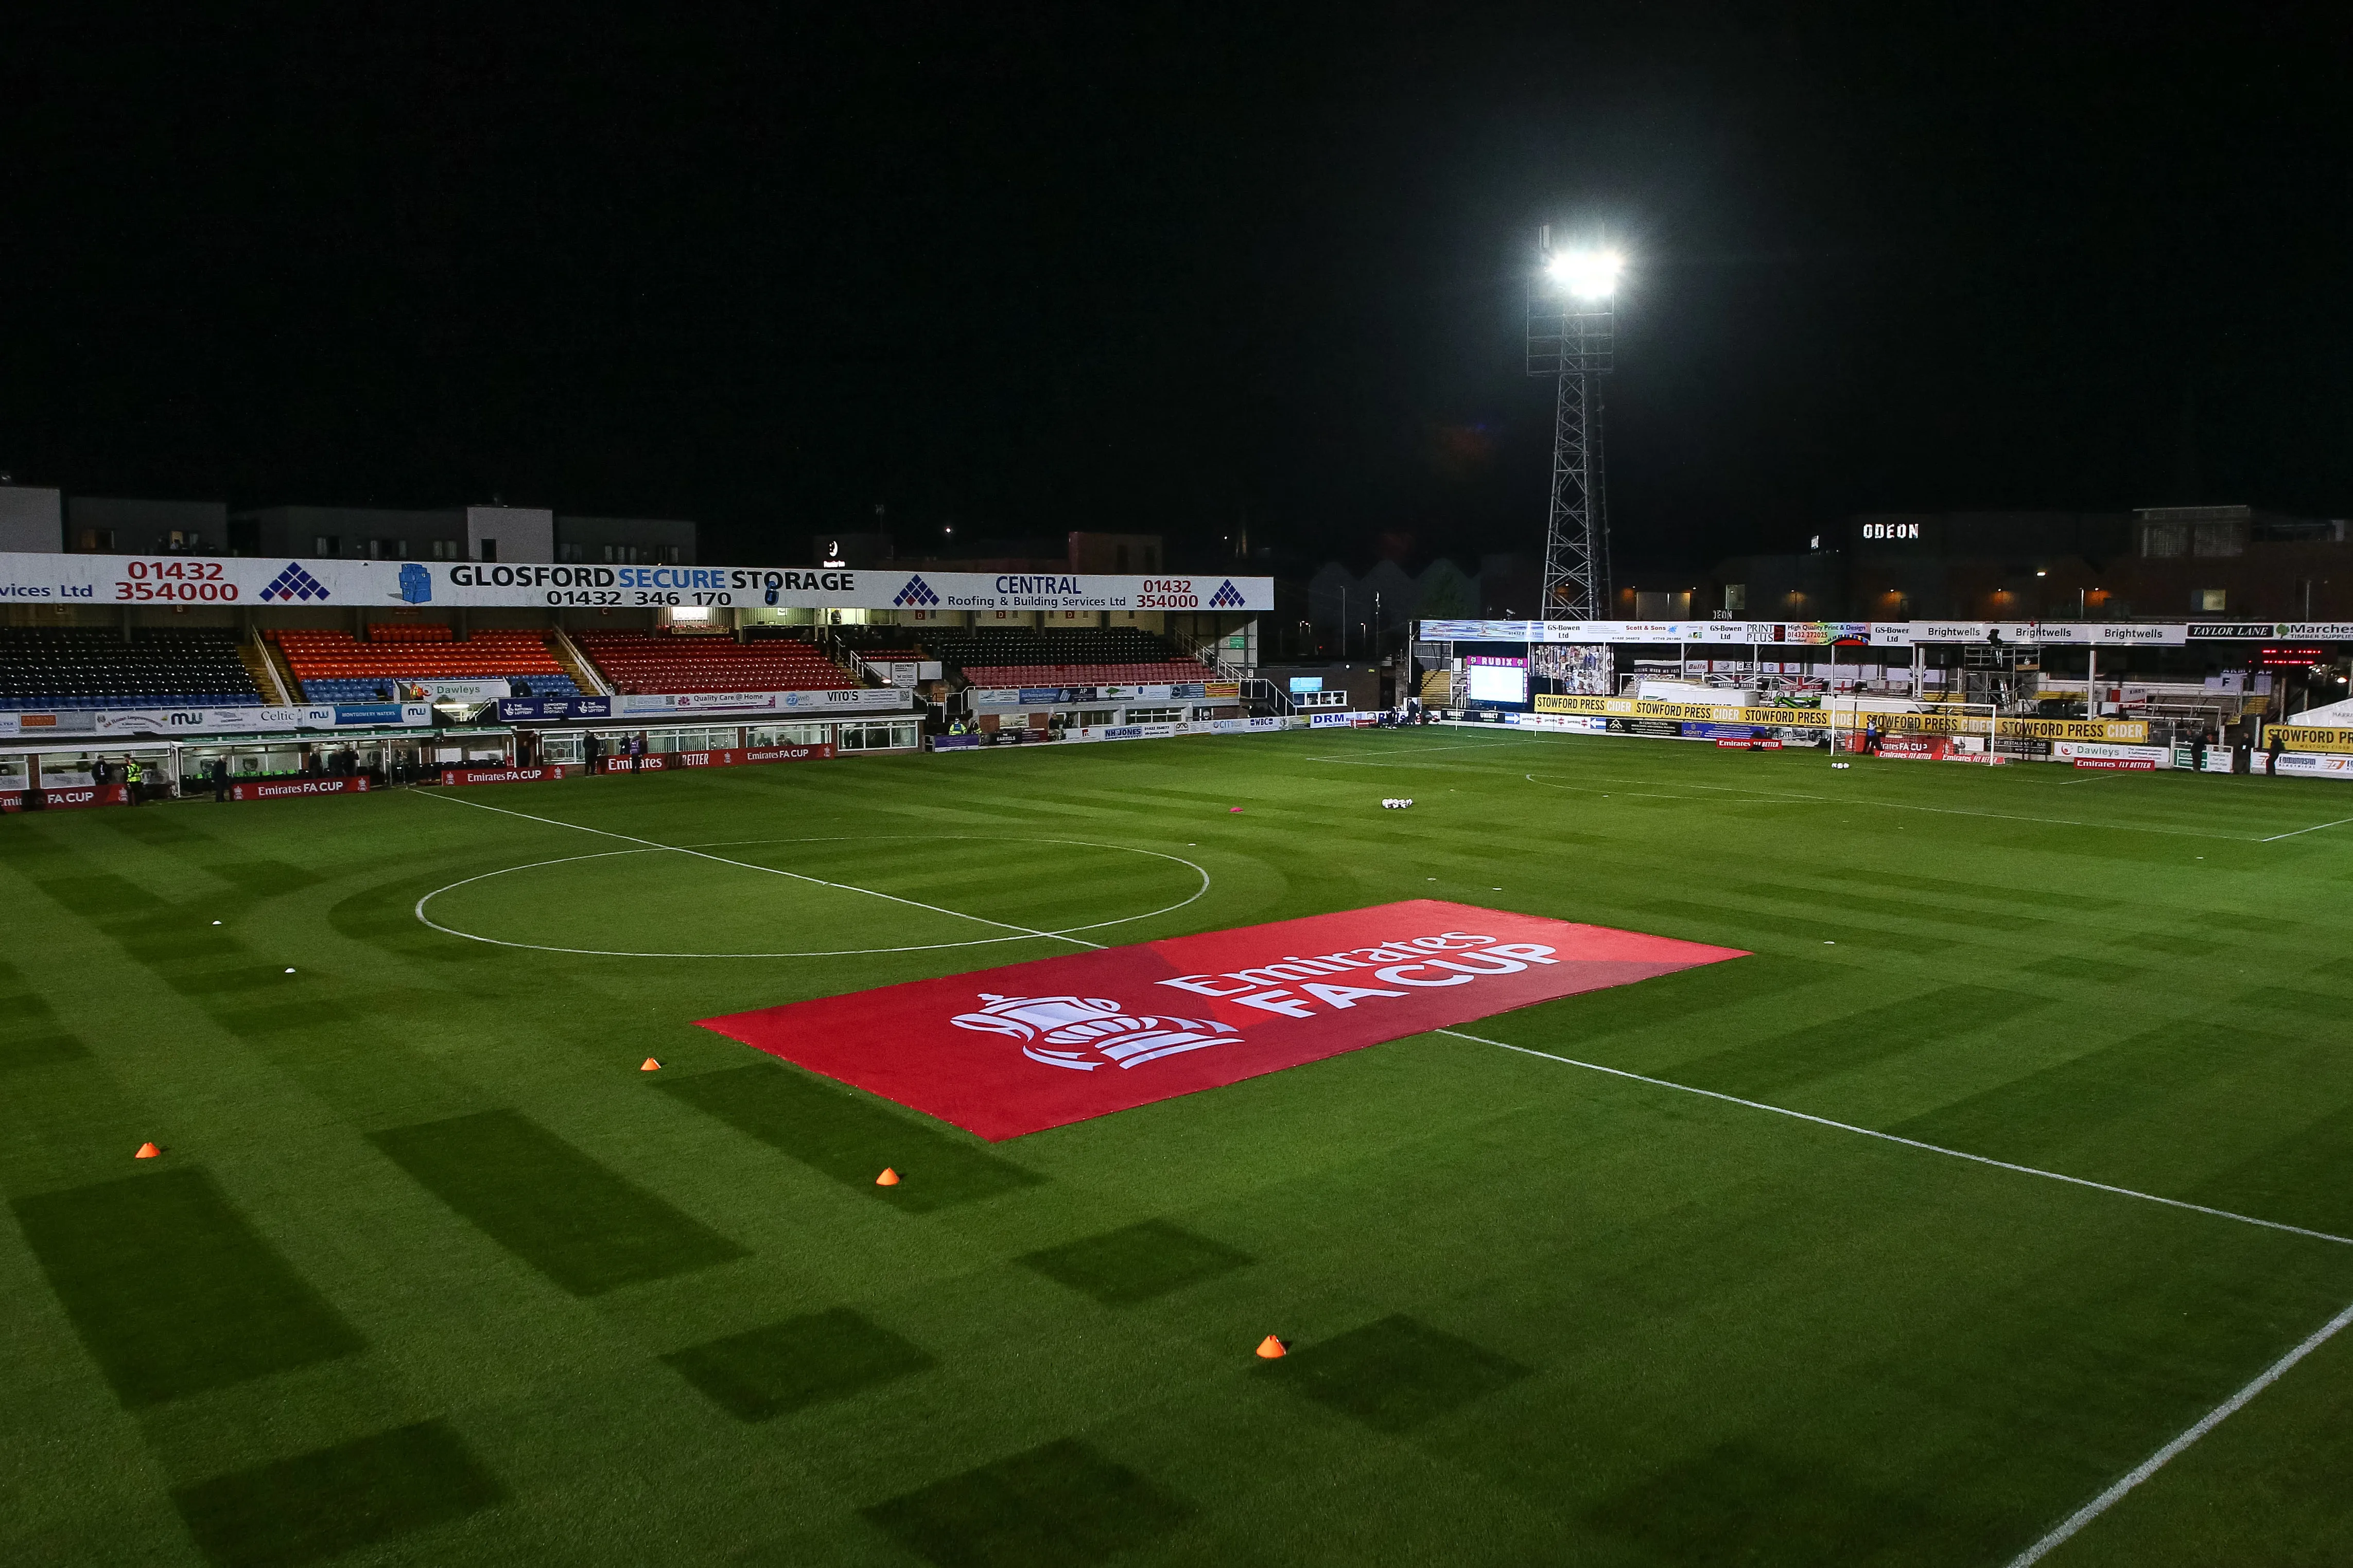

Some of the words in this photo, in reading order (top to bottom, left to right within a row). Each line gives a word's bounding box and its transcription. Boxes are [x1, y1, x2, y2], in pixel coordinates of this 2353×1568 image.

[1863, 524, 1919, 539] ODEON
[128, 561, 224, 580] 01432
[450, 565, 615, 587] GLOSFORD
[619, 569, 725, 589] SECURE
[731, 571, 855, 591] STORAGE
[0, 584, 50, 597] vices
[61, 585, 93, 597] Ltd
[115, 582, 238, 601] 354000
[996, 576, 1082, 594] CENTRAL
[1143, 579, 1192, 593] 01432
[547, 591, 622, 605] 01432
[634, 591, 680, 606] 346
[691, 592, 732, 606] 170
[948, 596, 995, 608] Roofing
[1000, 597, 1008, 606] &
[1014, 596, 1058, 608] Building
[1062, 597, 1105, 606] Services
[1110, 597, 1126, 606] Ltd
[1136, 595, 1198, 608] 354000
[1747, 633, 1773, 642] PLUS
[1928, 627, 1980, 638] Brightwells
[2016, 628, 2071, 638] Brightwells
[2104, 629, 2163, 640] Brightwells
[2193, 627, 2234, 636] TAYLOR
[2237, 627, 2269, 636] LANE
[438, 685, 480, 695] Dawleys
[827, 691, 859, 701] VITO'S
[1537, 697, 1577, 709] STOWFORD
[1580, 699, 1605, 710] PRESS
[1607, 700, 1632, 713] CIDER
[1636, 702, 1681, 716] STOWFORD
[1684, 706, 1711, 719] PRESS
[1713, 708, 1739, 720] CIDER
[261, 710, 294, 721] Celtic
[1254, 718, 1269, 726] WBC
[1314, 714, 1344, 724] DRM
[1745, 710, 1794, 723] STOWFORD
[1798, 712, 1827, 724] PRESS
[1867, 714, 1921, 729] STOWFORD
[1925, 717, 1957, 730] PRESS
[2001, 721, 2063, 736] STOWFORD
[2068, 724, 2104, 738] PRESS
[2107, 724, 2142, 738] CIDER
[2268, 729, 2334, 743] STOWFORD
[747, 752, 779, 760] Emirates
[779, 751, 789, 759] FA
[791, 749, 809, 758] CUP
[2077, 746, 2119, 756] Dawleys
[608, 757, 662, 770] Emiates
[682, 753, 709, 766] BETTER
[467, 773, 506, 782] Emirates
[507, 771, 519, 780] FA
[520, 770, 542, 779] CUP
[258, 785, 301, 797] Emirates
[303, 783, 318, 792] FA
[319, 781, 343, 791] CUP
[47, 794, 64, 803] FA
[66, 792, 94, 802] CUP
[1154, 931, 1497, 997] Emirates
[1230, 982, 1410, 1018] FA
[1374, 943, 1560, 988] CUP
